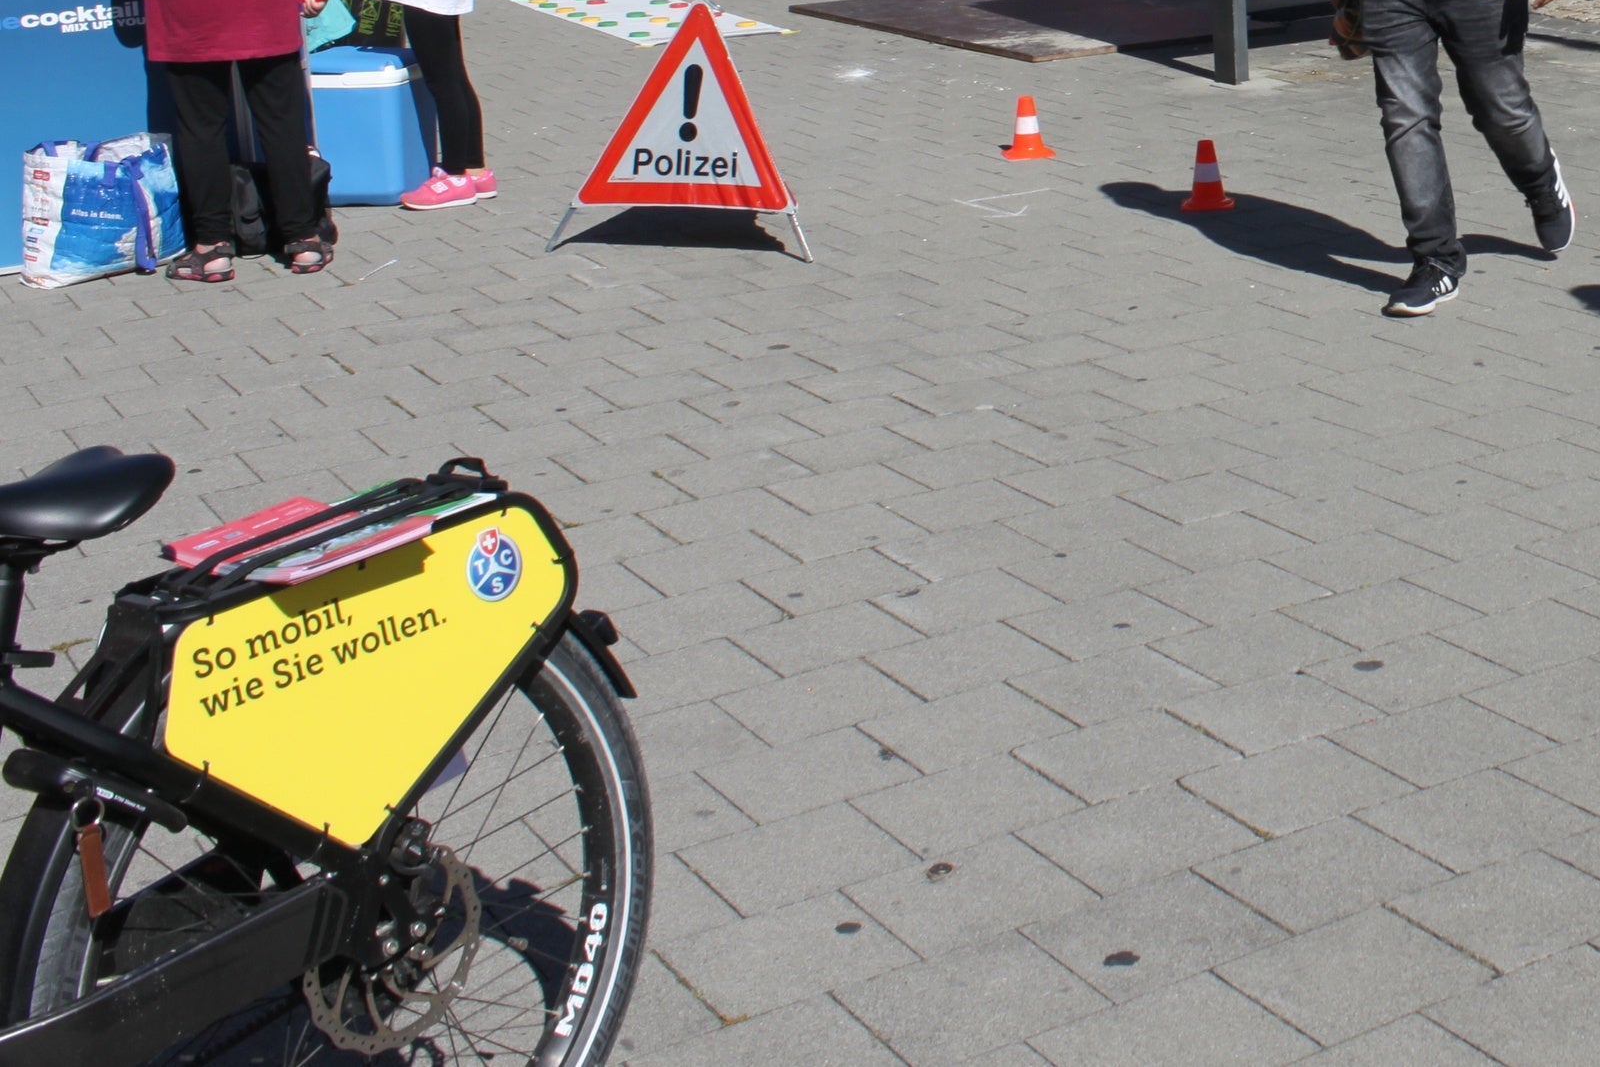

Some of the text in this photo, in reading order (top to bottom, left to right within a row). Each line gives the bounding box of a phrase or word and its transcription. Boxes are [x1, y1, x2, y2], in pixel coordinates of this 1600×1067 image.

[61, 22, 90, 34] MIX
[92, 20, 113, 31] UP
[633, 148, 738, 178] Polizei
[71, 208, 124, 221] Alles in Einem.
[192, 597, 353, 679] So mobil,
[199, 607, 448, 718] wie Sie wollen.
[554, 902, 608, 1038] MD40
